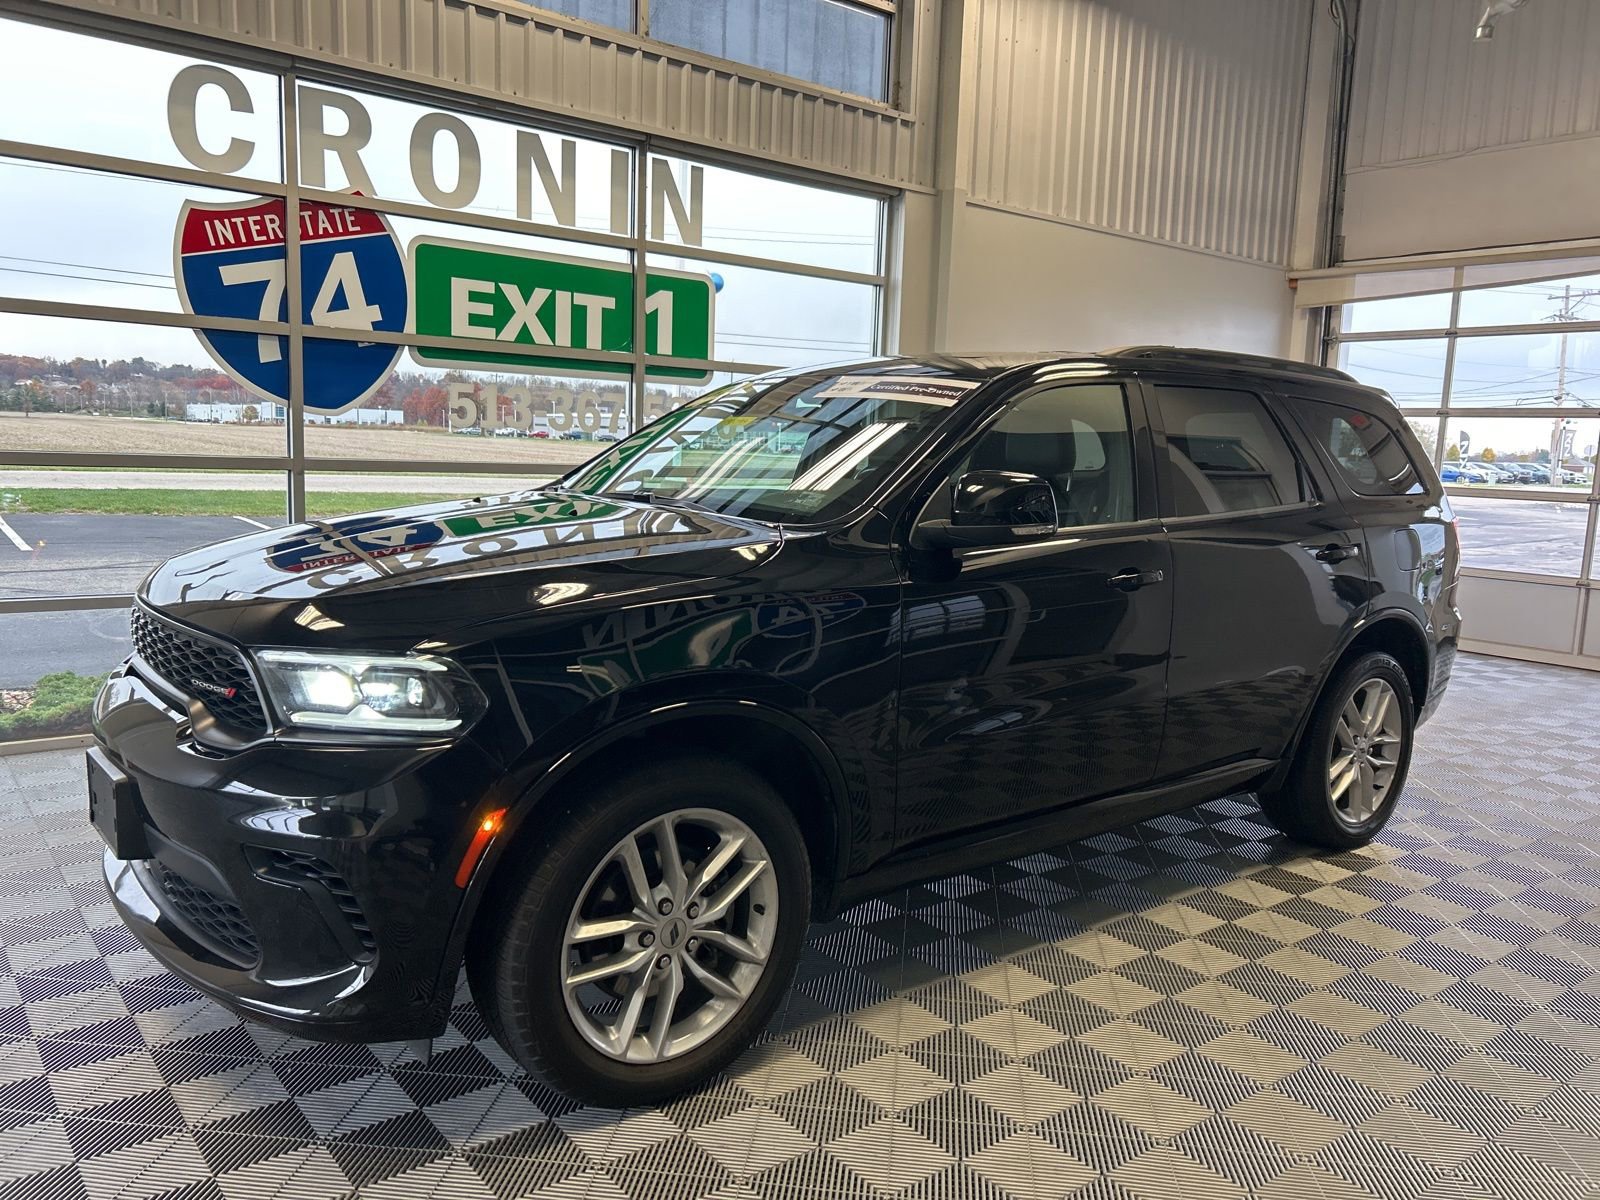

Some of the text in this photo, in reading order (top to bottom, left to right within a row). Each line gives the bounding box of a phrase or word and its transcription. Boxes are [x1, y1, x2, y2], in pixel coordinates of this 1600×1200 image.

[167, 64, 704, 248] CRONIN
[204, 207, 361, 247] INTERTATE
[218, 251, 383, 364] 74
[450, 276, 674, 355] EXIT 1
[870, 383, 909, 393] Certified
[909, 384, 962, 398] Pre-Owned
[191, 679, 229, 695] DODGE
